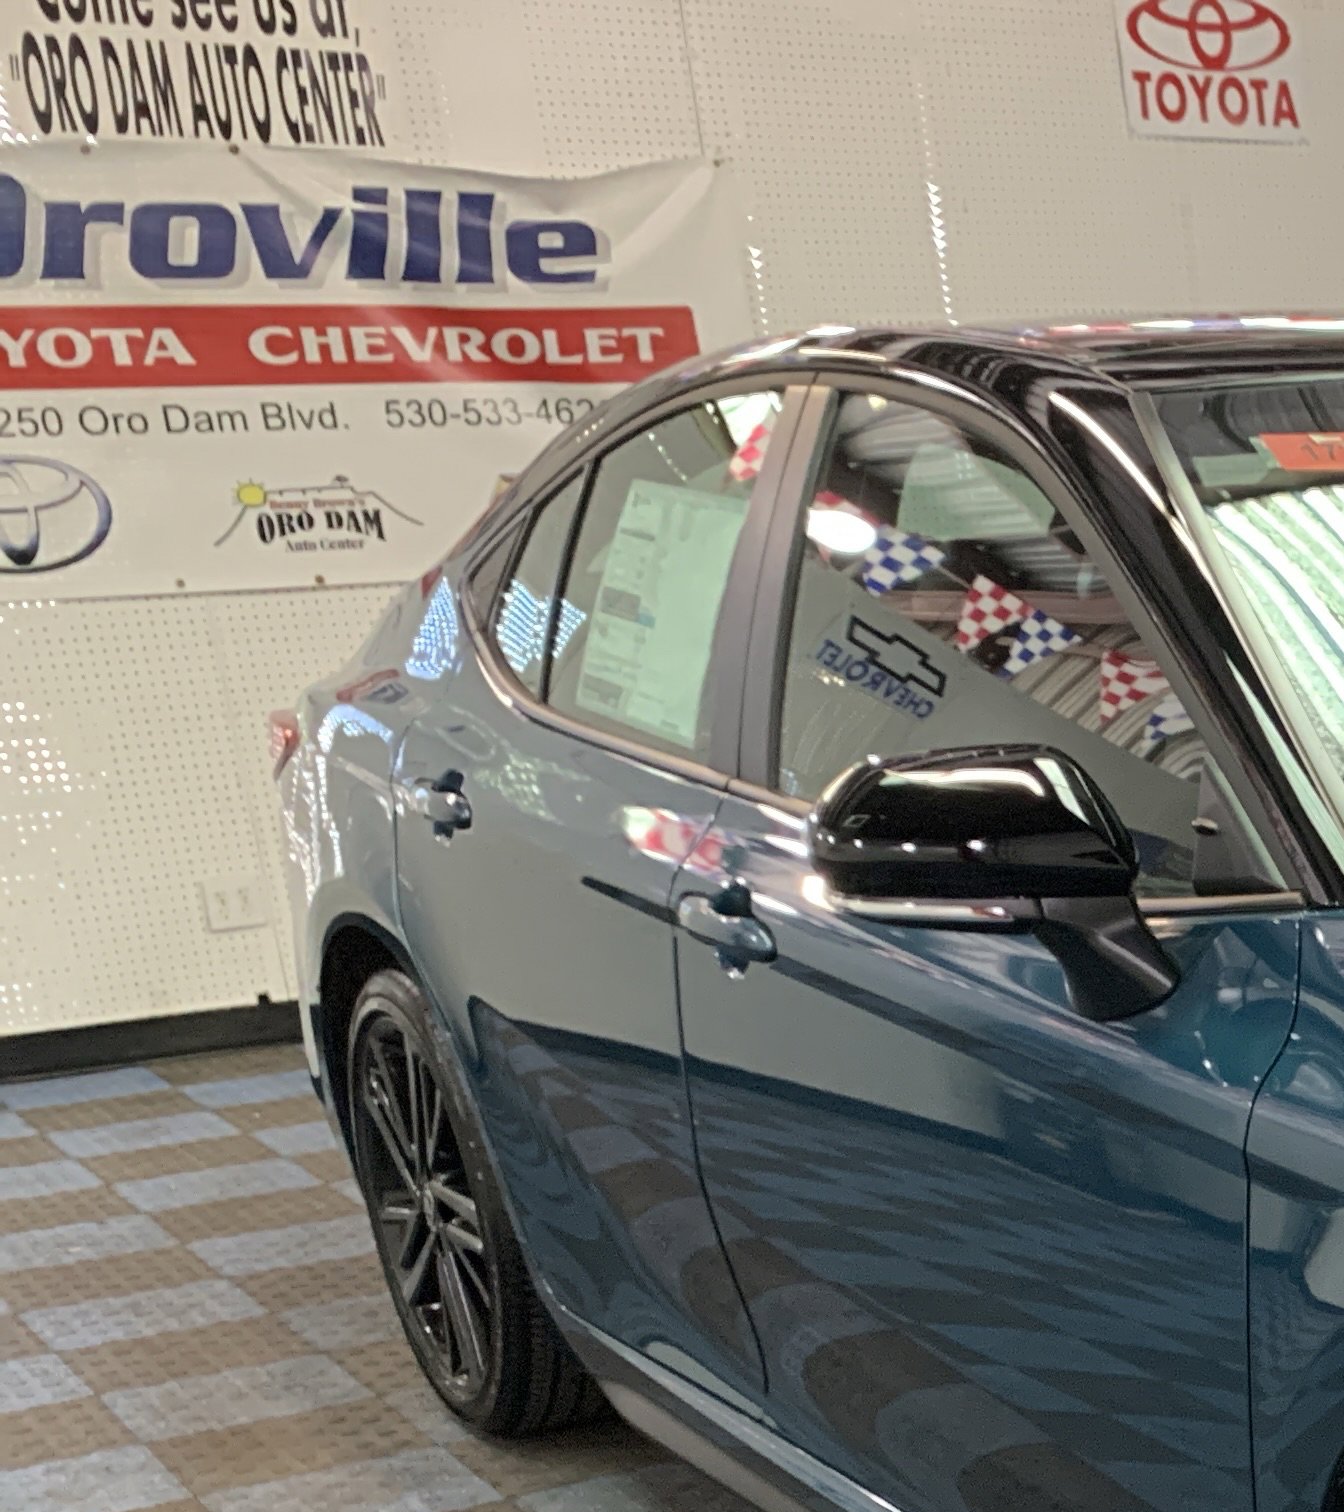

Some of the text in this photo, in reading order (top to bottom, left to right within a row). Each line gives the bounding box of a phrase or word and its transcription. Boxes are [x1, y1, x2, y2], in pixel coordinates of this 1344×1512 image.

[170, 0, 238, 32] see
[254, 0, 297, 36] us
[9, 31, 386, 147] "ORO DAM AUTO CENTER"
[1132, 70, 1300, 128] TOYOTA
[0, 172, 597, 284] roville
[248, 326, 664, 365] CHEVROLET
[79, 405, 149, 436] Oro
[163, 403, 248, 433] Dam
[264, 401, 350, 431] Blvd.
[256, 507, 386, 544] ORO DAM
